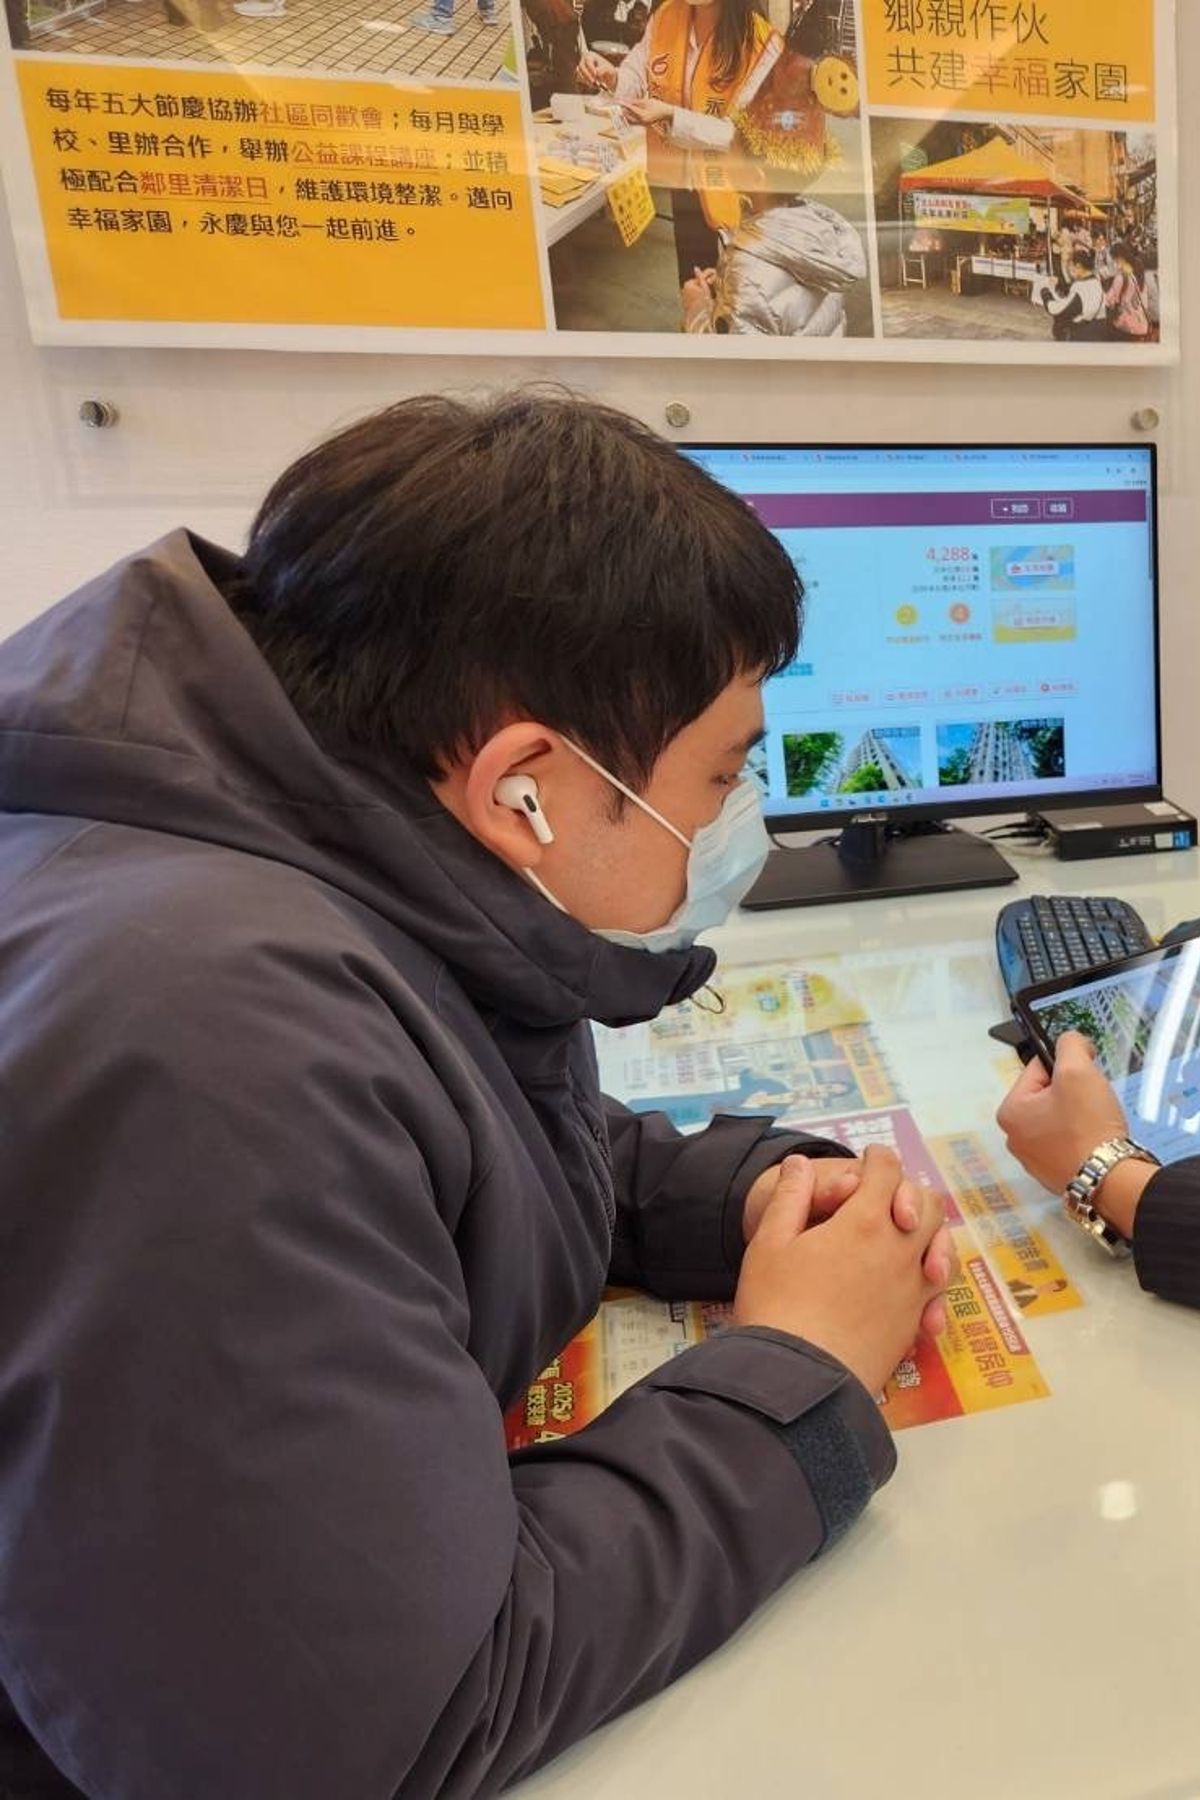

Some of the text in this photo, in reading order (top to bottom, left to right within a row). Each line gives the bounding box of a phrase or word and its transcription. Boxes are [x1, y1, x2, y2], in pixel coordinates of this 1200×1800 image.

[885, 0, 1049, 45] 鄉親作伙
[887, 45, 1128, 103] 共建幸福家園
[944, 1276, 981, 1318] 房屋
